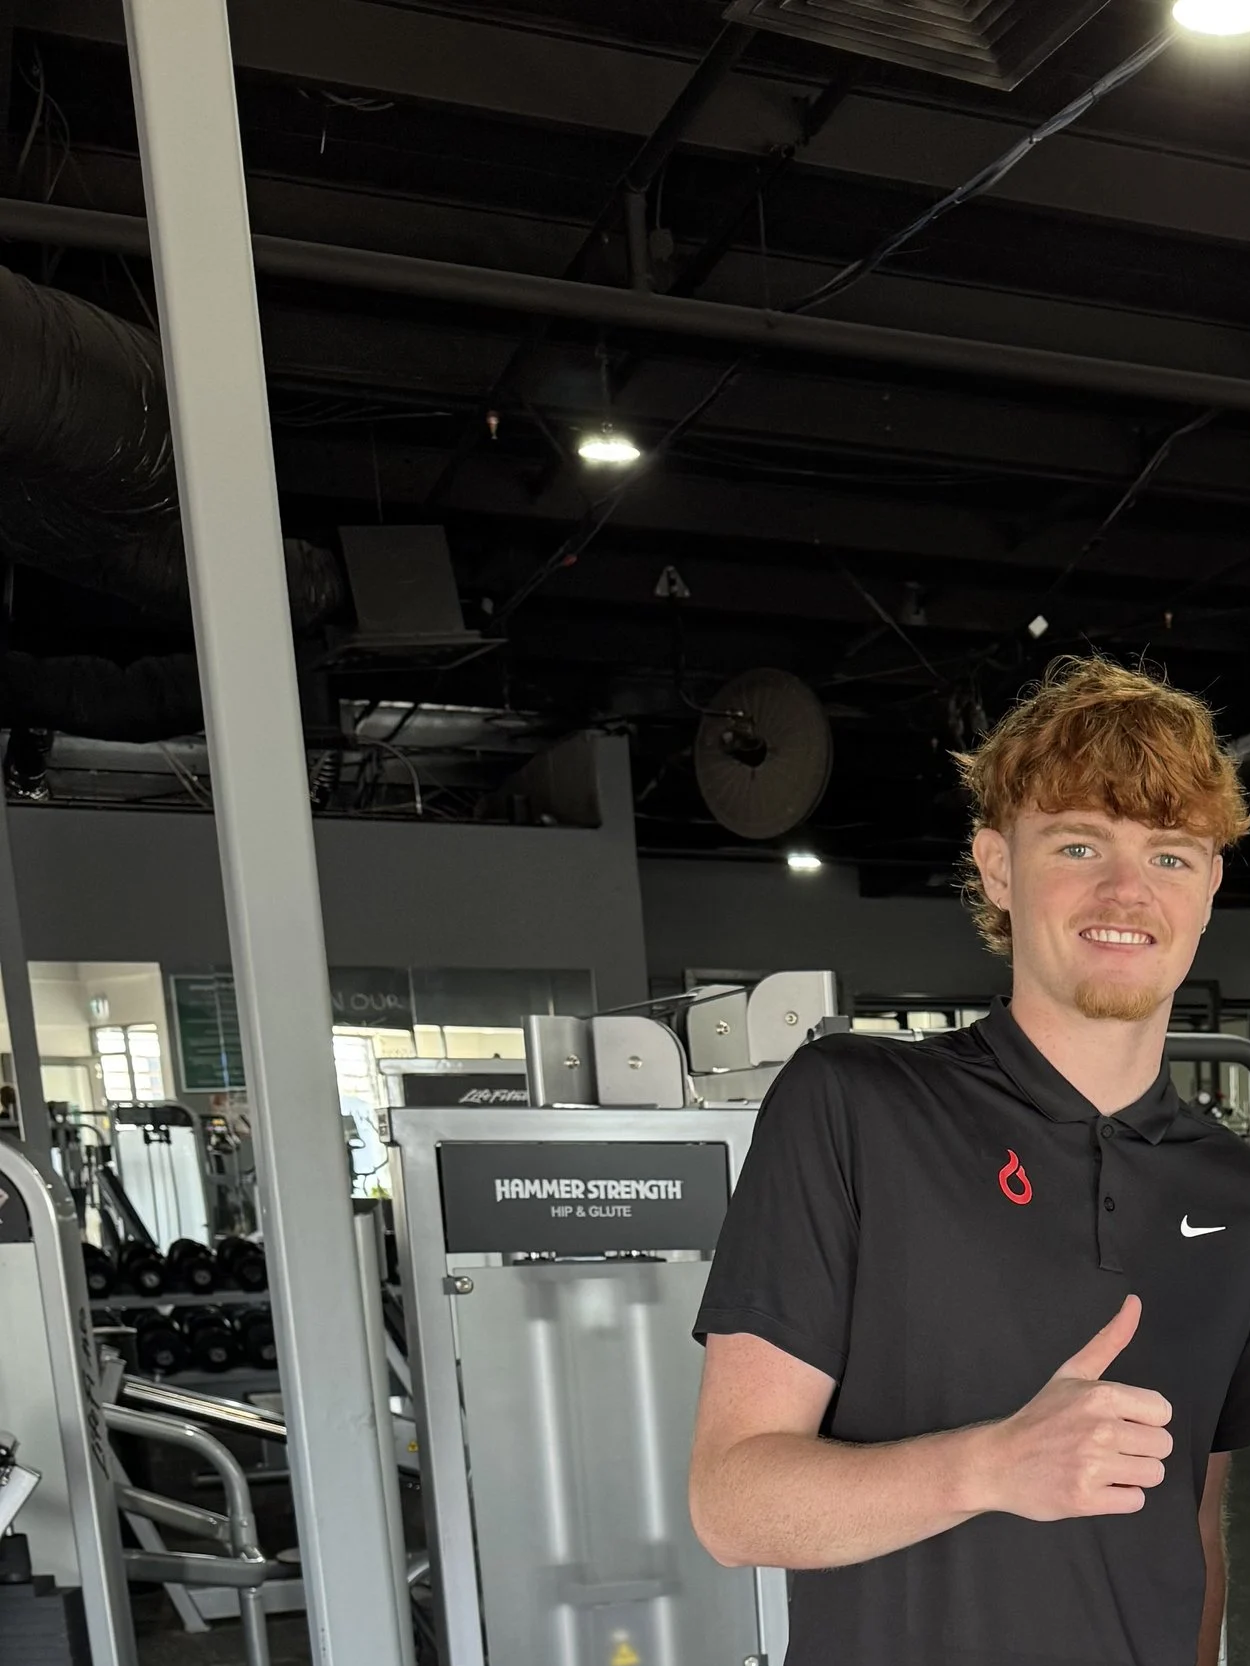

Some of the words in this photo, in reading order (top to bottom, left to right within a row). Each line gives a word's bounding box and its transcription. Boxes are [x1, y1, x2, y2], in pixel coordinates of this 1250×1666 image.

[350, 992, 406, 1011] OUR
[494, 1178, 586, 1203] HAMMER
[587, 1179, 683, 1200] STRENGTH
[551, 1205, 573, 1218] HIP
[576, 1205, 586, 1218] &
[588, 1205, 633, 1218] GLUTE
